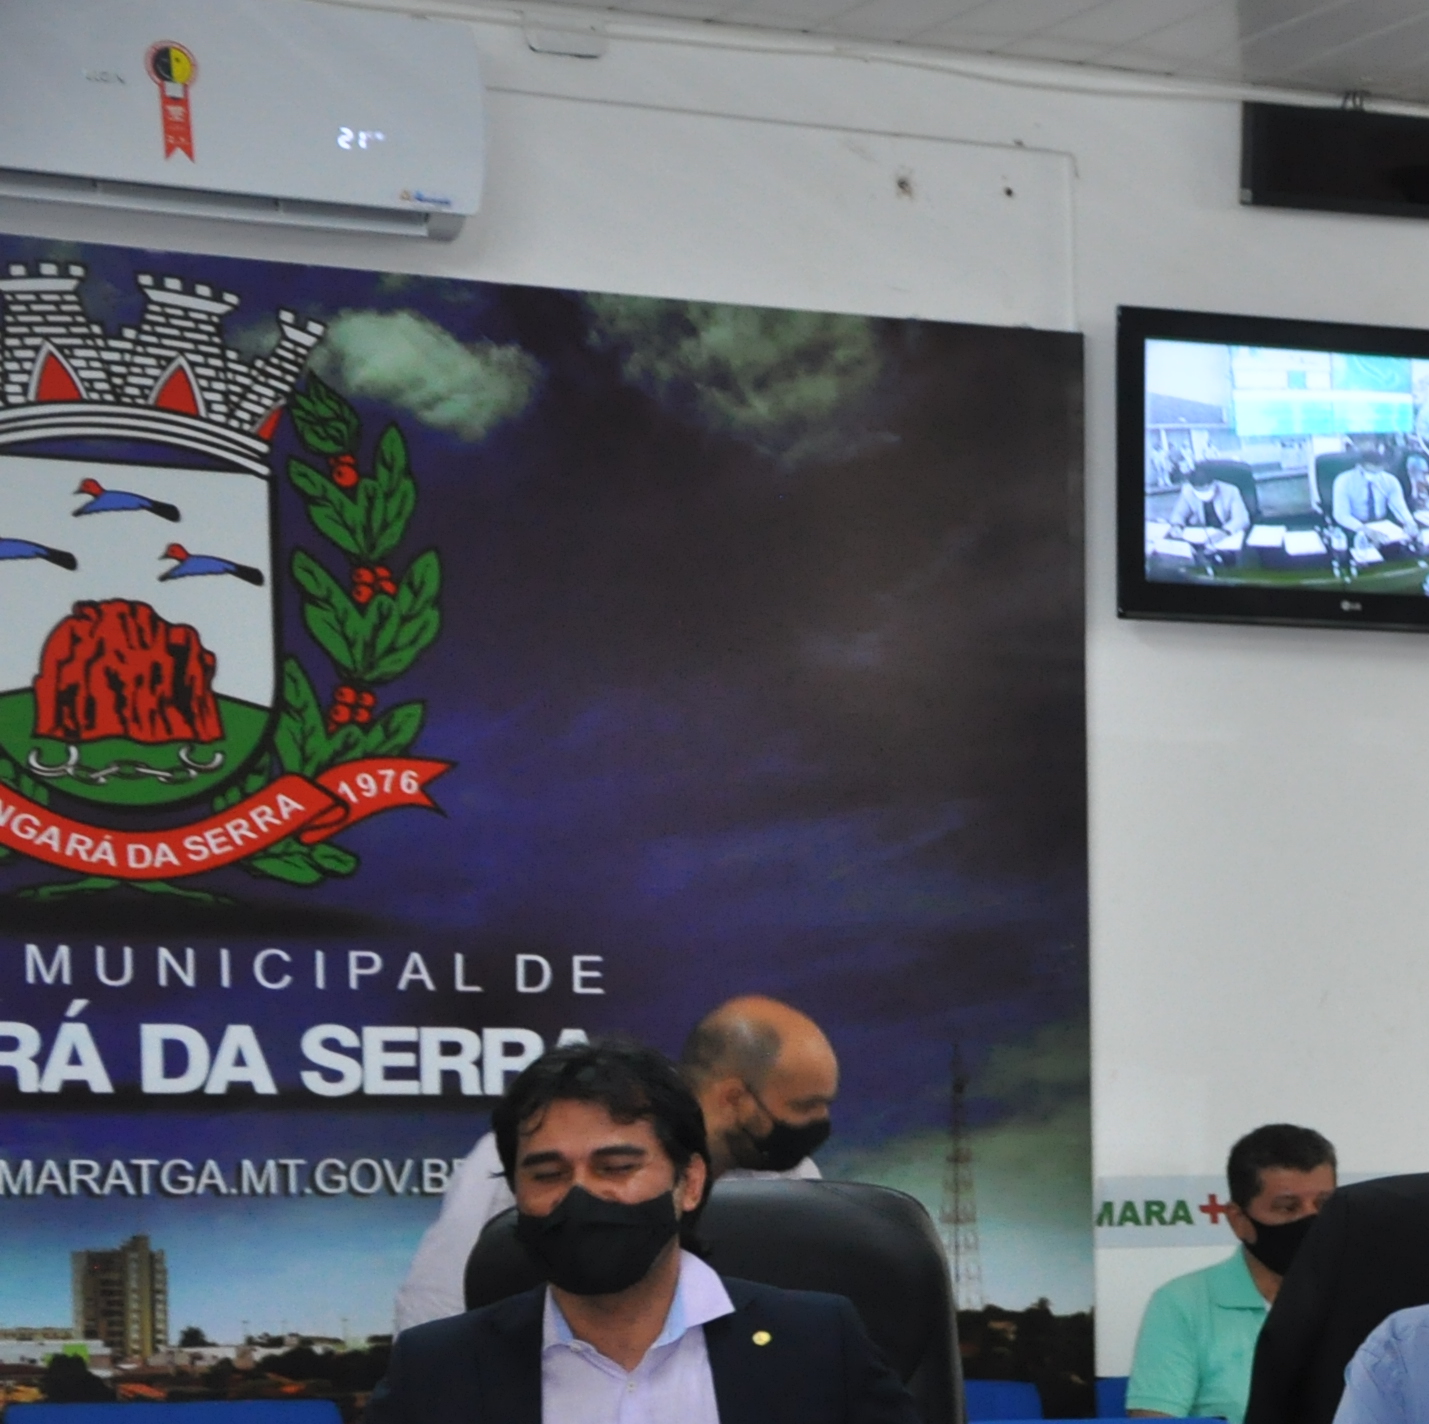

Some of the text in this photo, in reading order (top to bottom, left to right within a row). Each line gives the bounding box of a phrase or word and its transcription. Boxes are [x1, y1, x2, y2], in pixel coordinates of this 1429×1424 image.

[126, 843, 180, 869] DA
[182, 792, 305, 863] SERRA
[338, 768, 419, 804] 1976
[24, 943, 607, 995] MUNICIPAL DE
[139, 1022, 278, 1095] DA
[300, 1023, 592, 1097] SERR
